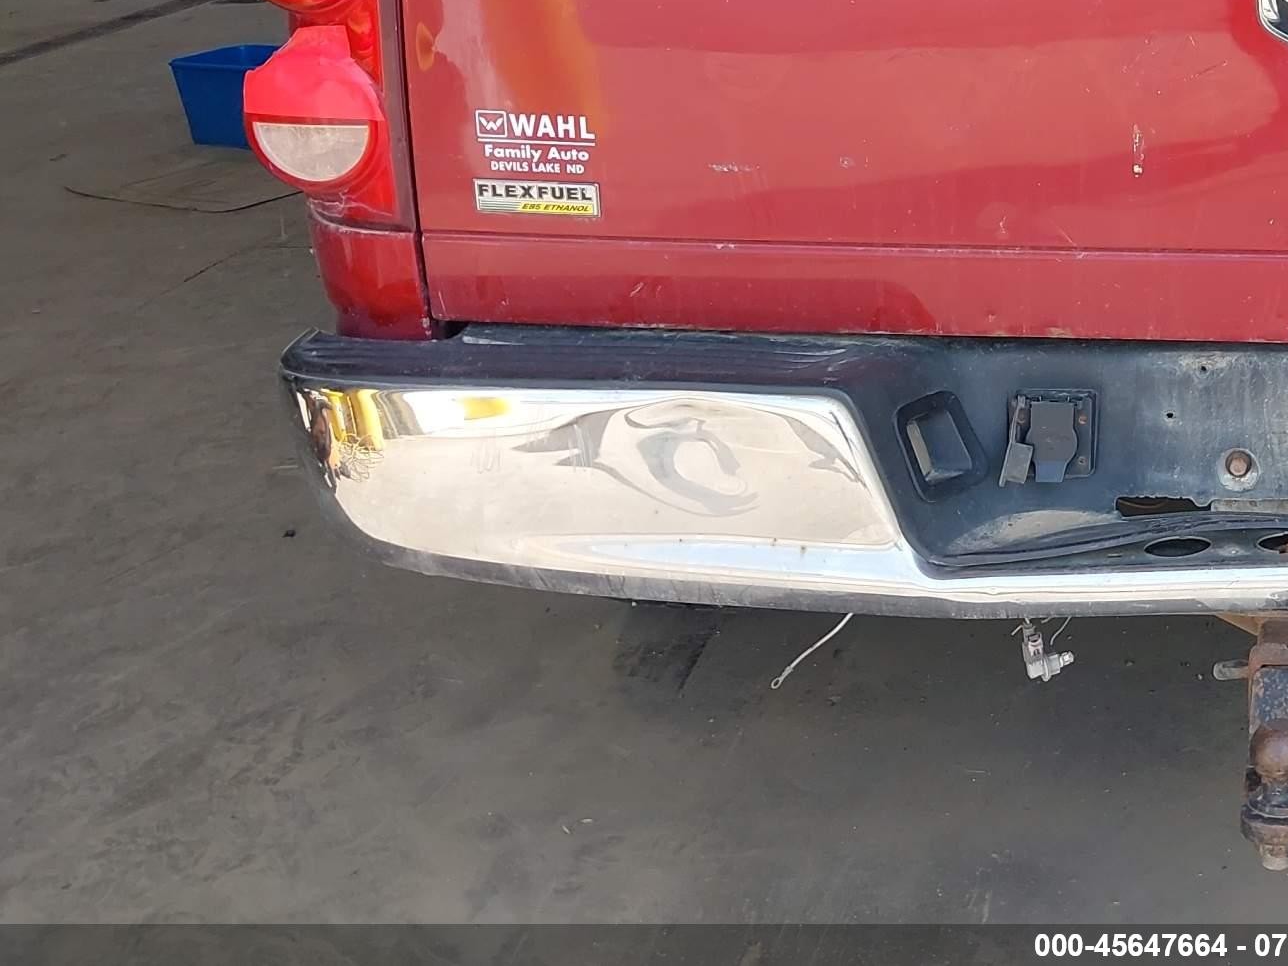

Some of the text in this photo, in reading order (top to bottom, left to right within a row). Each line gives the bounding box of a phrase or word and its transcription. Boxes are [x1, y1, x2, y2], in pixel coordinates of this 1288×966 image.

[508, 113, 596, 140] WAHL
[484, 143, 590, 163] Family Auto
[490, 161, 585, 175] DEVILS LAKE ND
[478, 183, 593, 202] FLEXFUEL
[521, 202, 591, 213] E85 ETHANOL
